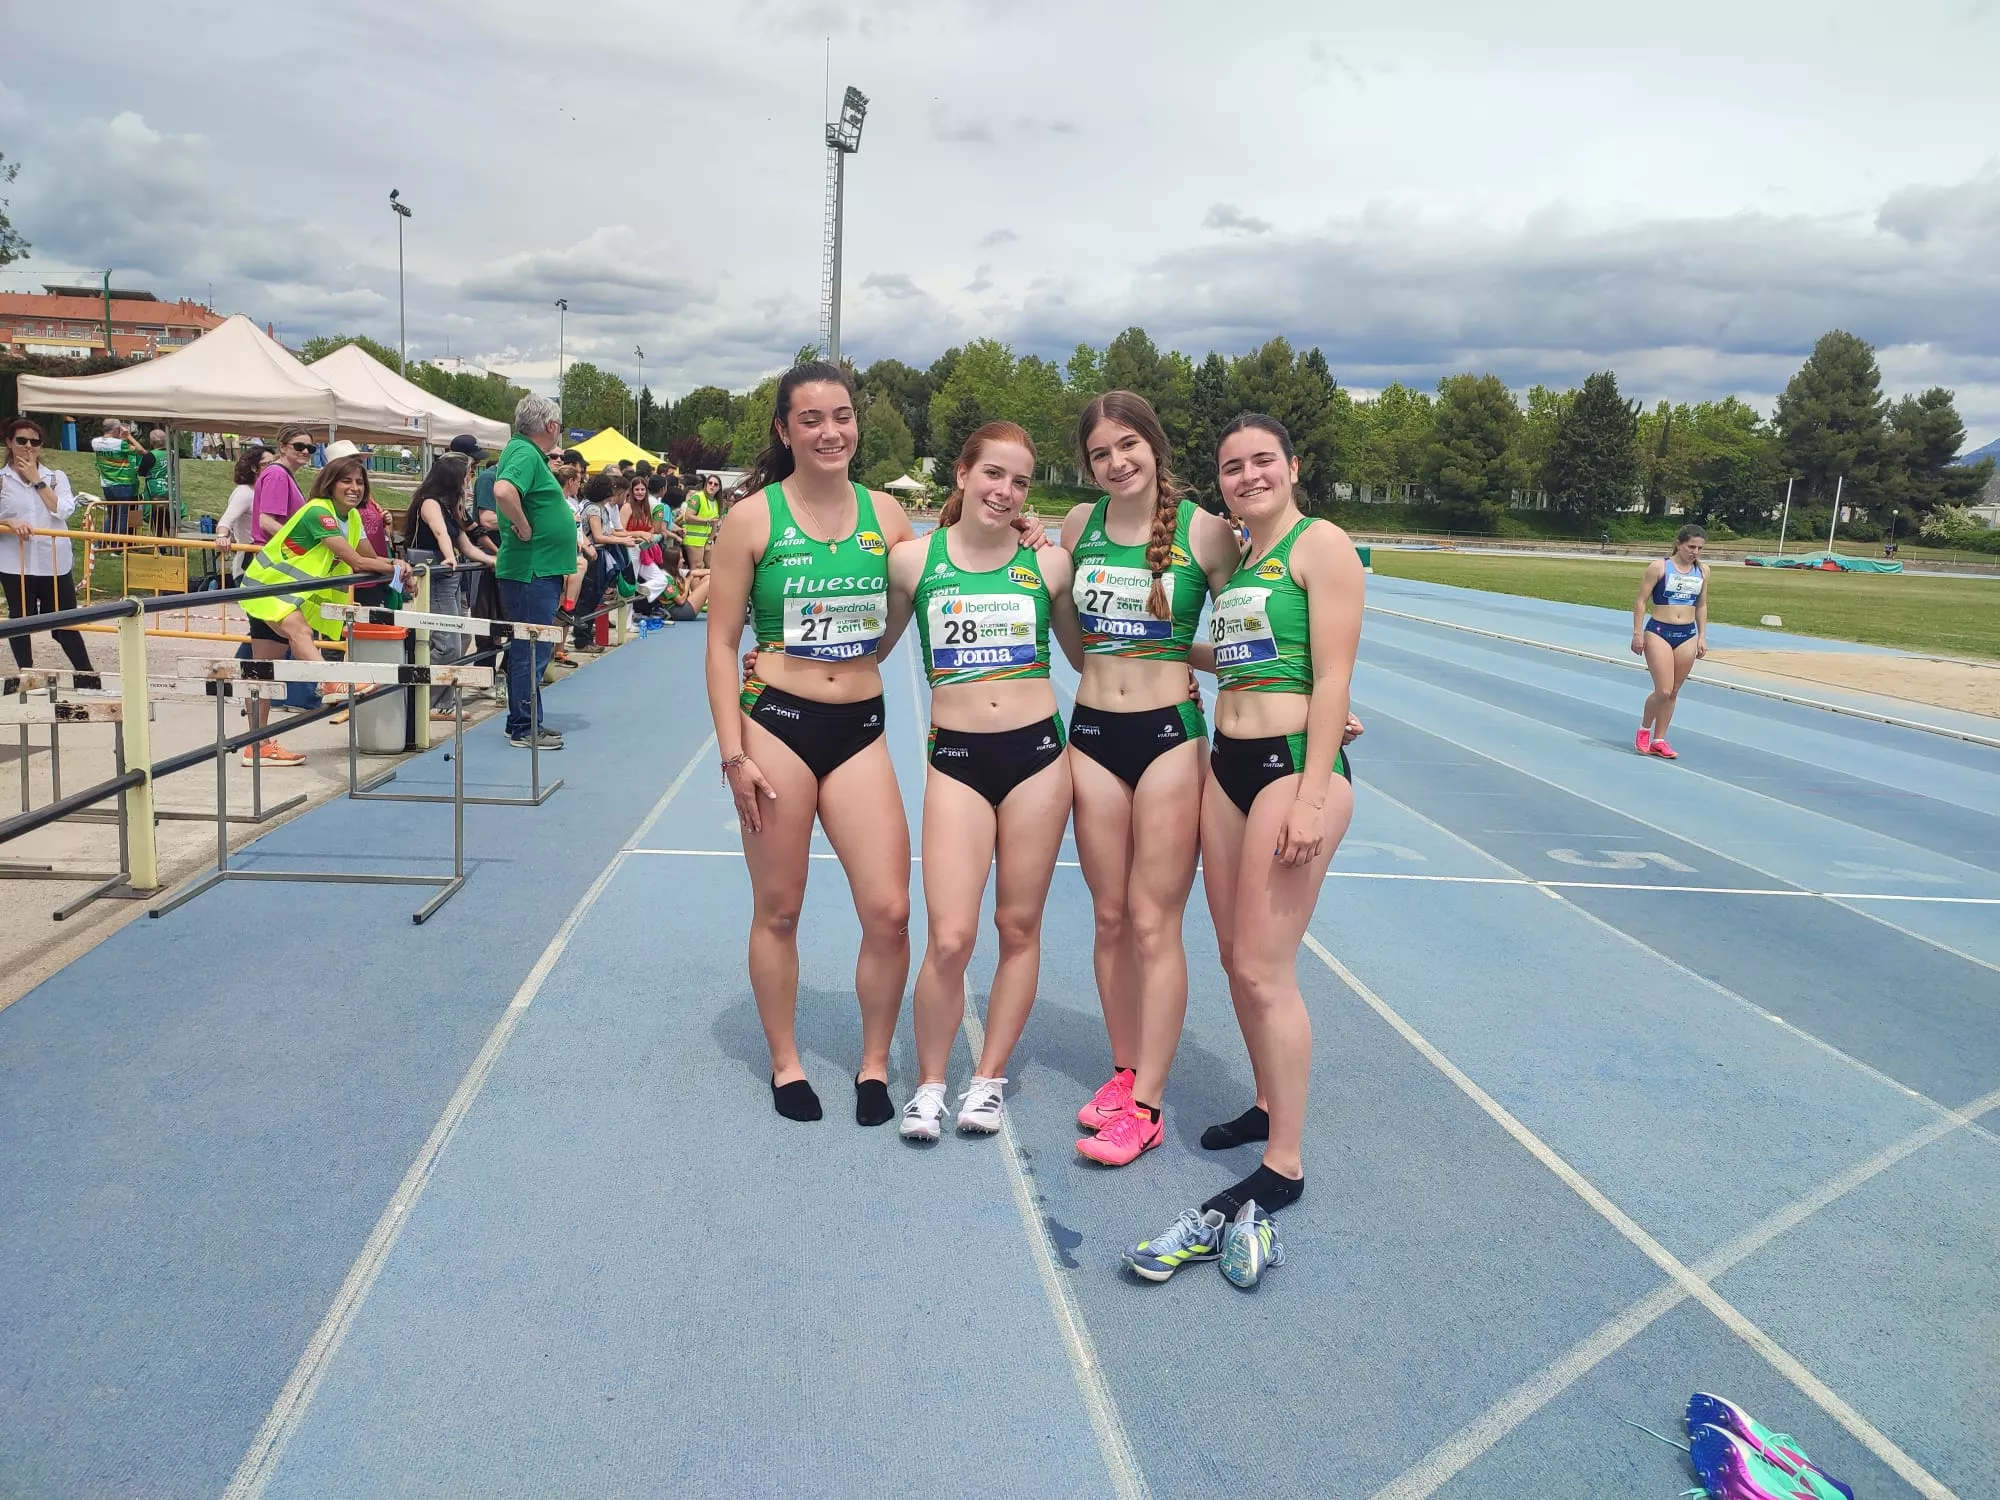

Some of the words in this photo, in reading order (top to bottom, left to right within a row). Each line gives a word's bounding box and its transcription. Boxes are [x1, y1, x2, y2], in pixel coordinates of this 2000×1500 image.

[774, 539, 806, 548] VIATOR
[782, 556, 813, 567] ZOITI
[783, 576, 884, 595] Huesca
[1106, 575, 1151, 588] Iberdrol
[1676, 583, 1683, 591] 5
[825, 602, 876, 613] Iberdrola
[965, 601, 1020, 613] Iberdrola
[1085, 589, 1114, 614] 27
[1116, 602, 1142, 612] ZOITI
[801, 617, 833, 641] 27
[837, 624, 861, 633] ZOITI
[944, 620, 977, 644] 28
[980, 628, 1008, 637] ZOITI
[1210, 617, 1225, 642] 28
[776, 708, 800, 720] ZOITI
[948, 750, 969, 758] ZOITI
[1546, 849, 1699, 873] 5
